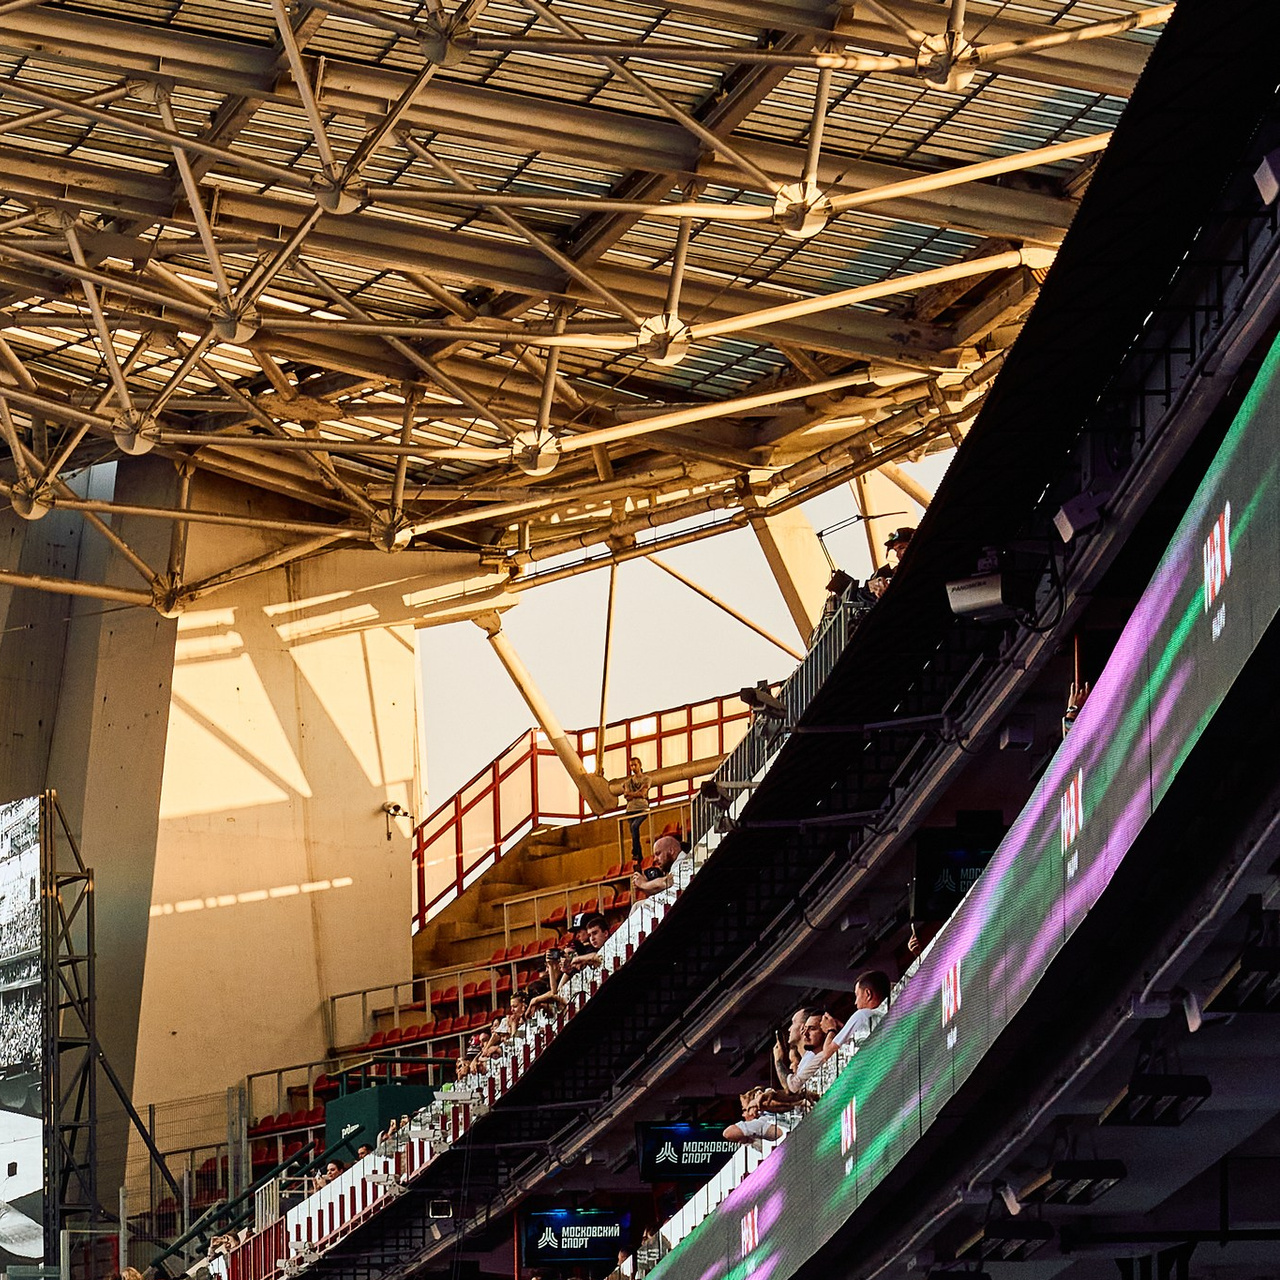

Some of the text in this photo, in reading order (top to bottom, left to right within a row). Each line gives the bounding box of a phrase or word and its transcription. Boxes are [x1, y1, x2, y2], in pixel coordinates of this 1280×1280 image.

[682, 1141, 741, 1153] МОСКОВСКИ
[682, 1153, 712, 1164] СПОРТ
[561, 1224, 620, 1238] МОСКОВСКИЙ
[561, 1237, 589, 1249] СПОРТ
